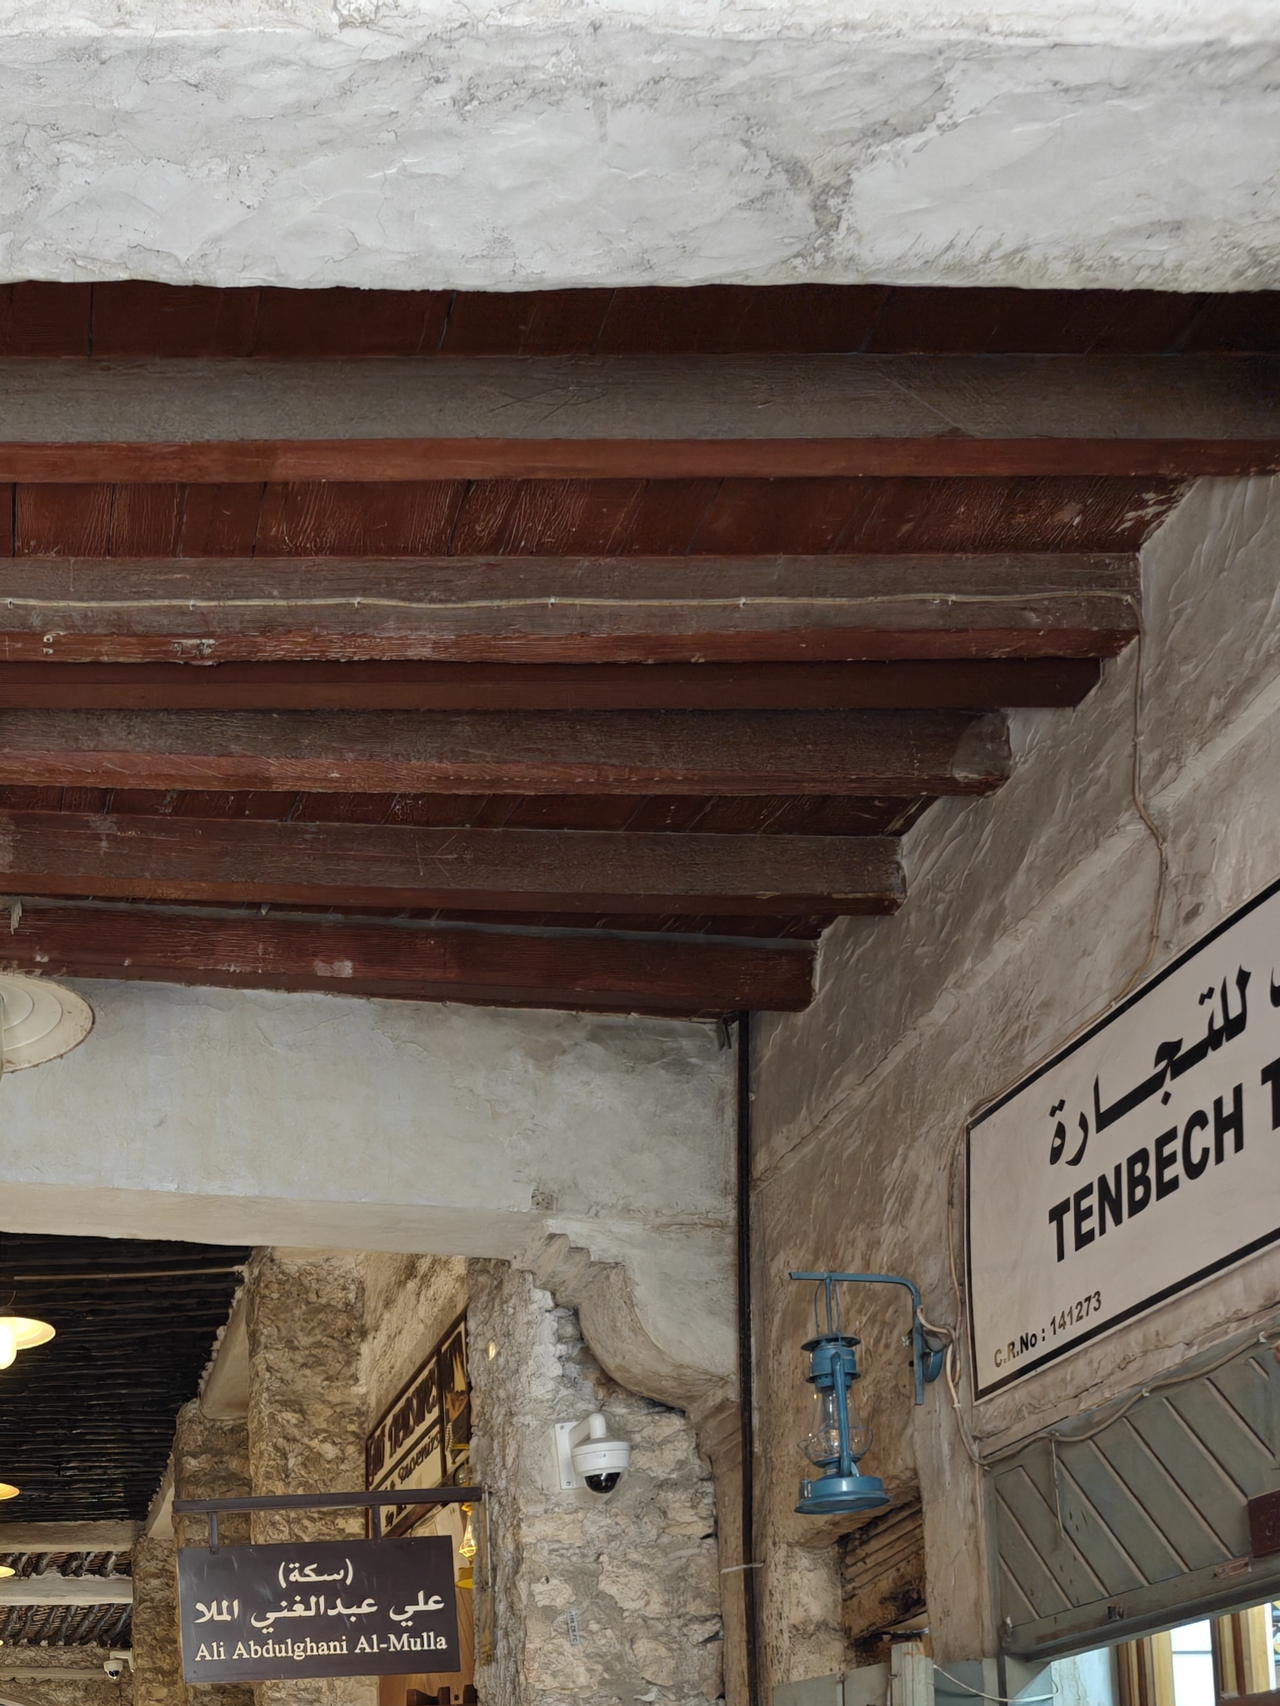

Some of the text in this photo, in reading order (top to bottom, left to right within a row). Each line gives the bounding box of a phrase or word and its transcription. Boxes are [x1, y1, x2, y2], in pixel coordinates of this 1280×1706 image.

[1048, 965, 1251, 1166] للتجارة
[1048, 1082, 1244, 1263] TENBECH
[1050, 1290, 1102, 1336] 141273
[277, 1558, 353, 1588] (سكة)
[194, 1599, 239, 1623] الملا
[389, 1590, 445, 1627] علي
[194, 1632, 448, 1662] Ali Abdulghani Al-Mulla
